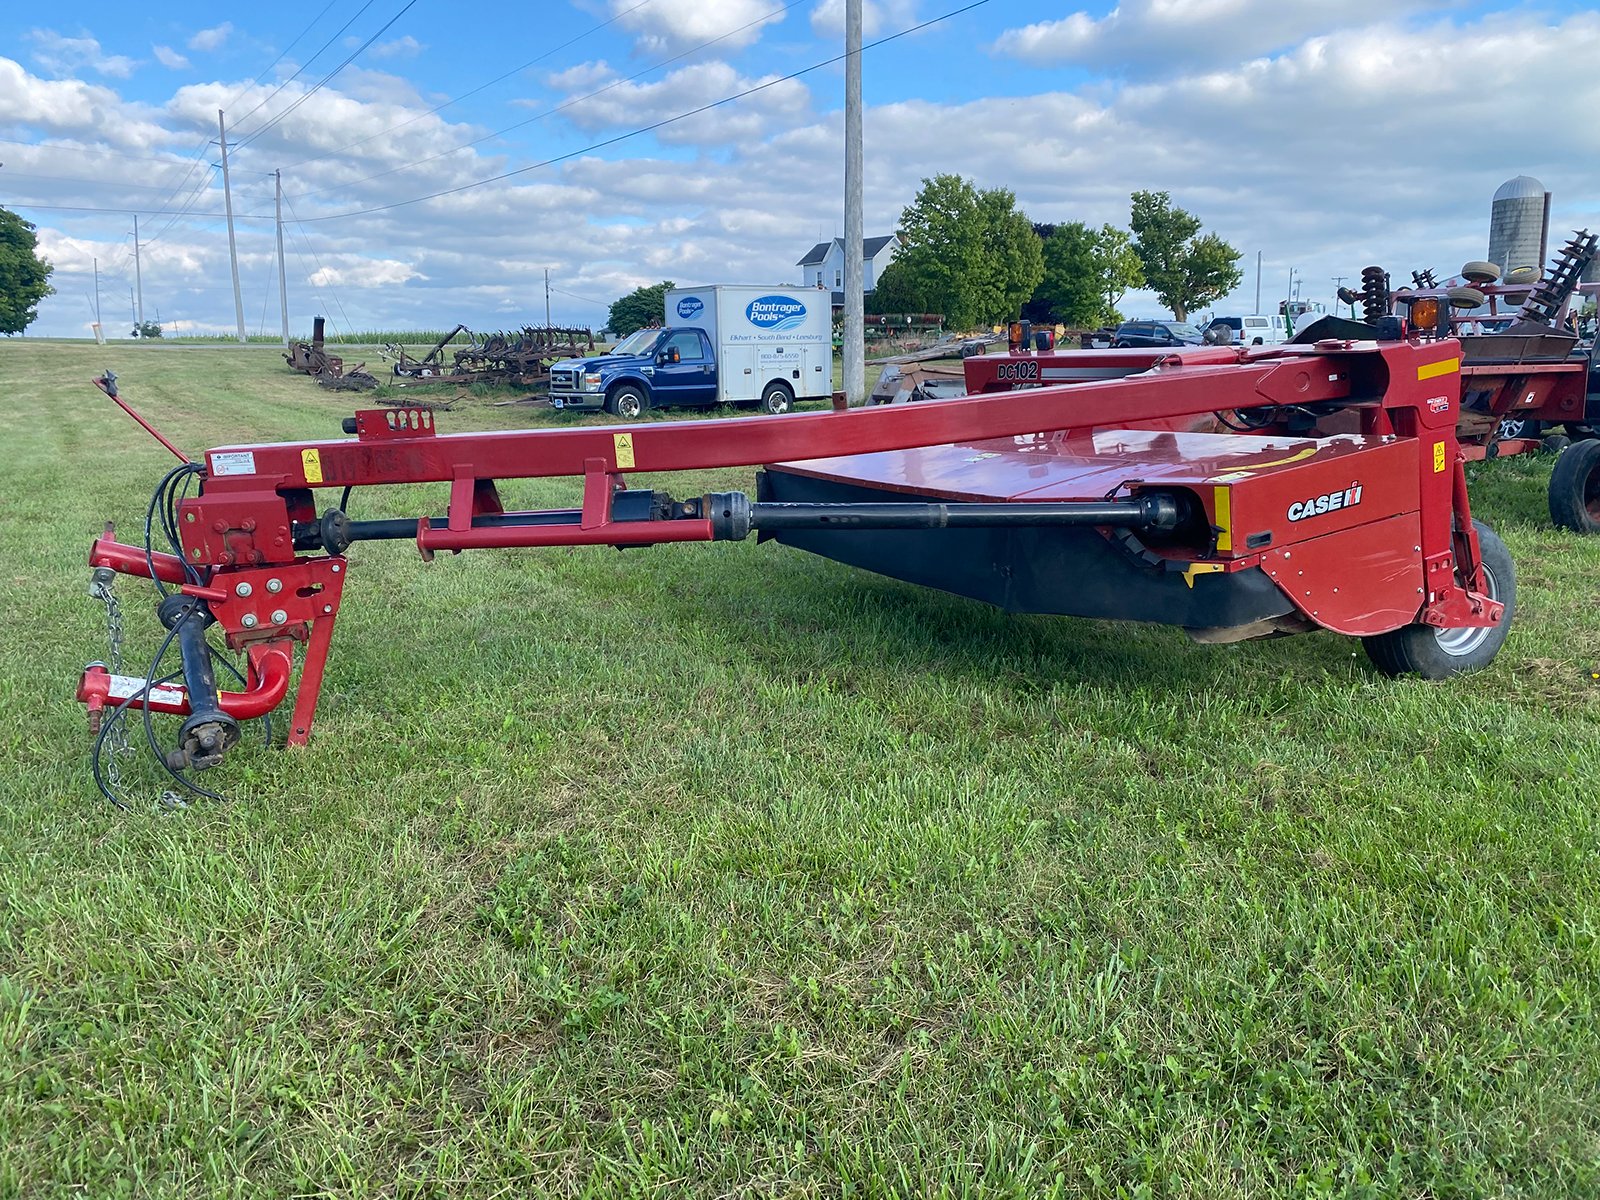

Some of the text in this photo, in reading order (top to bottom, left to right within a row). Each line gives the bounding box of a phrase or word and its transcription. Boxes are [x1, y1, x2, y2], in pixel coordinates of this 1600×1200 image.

[750, 311, 778, 321] Pools
[752, 302, 802, 314] Bontrager
[997, 360, 1039, 380] DC102
[1287, 490, 1344, 521] CASE
